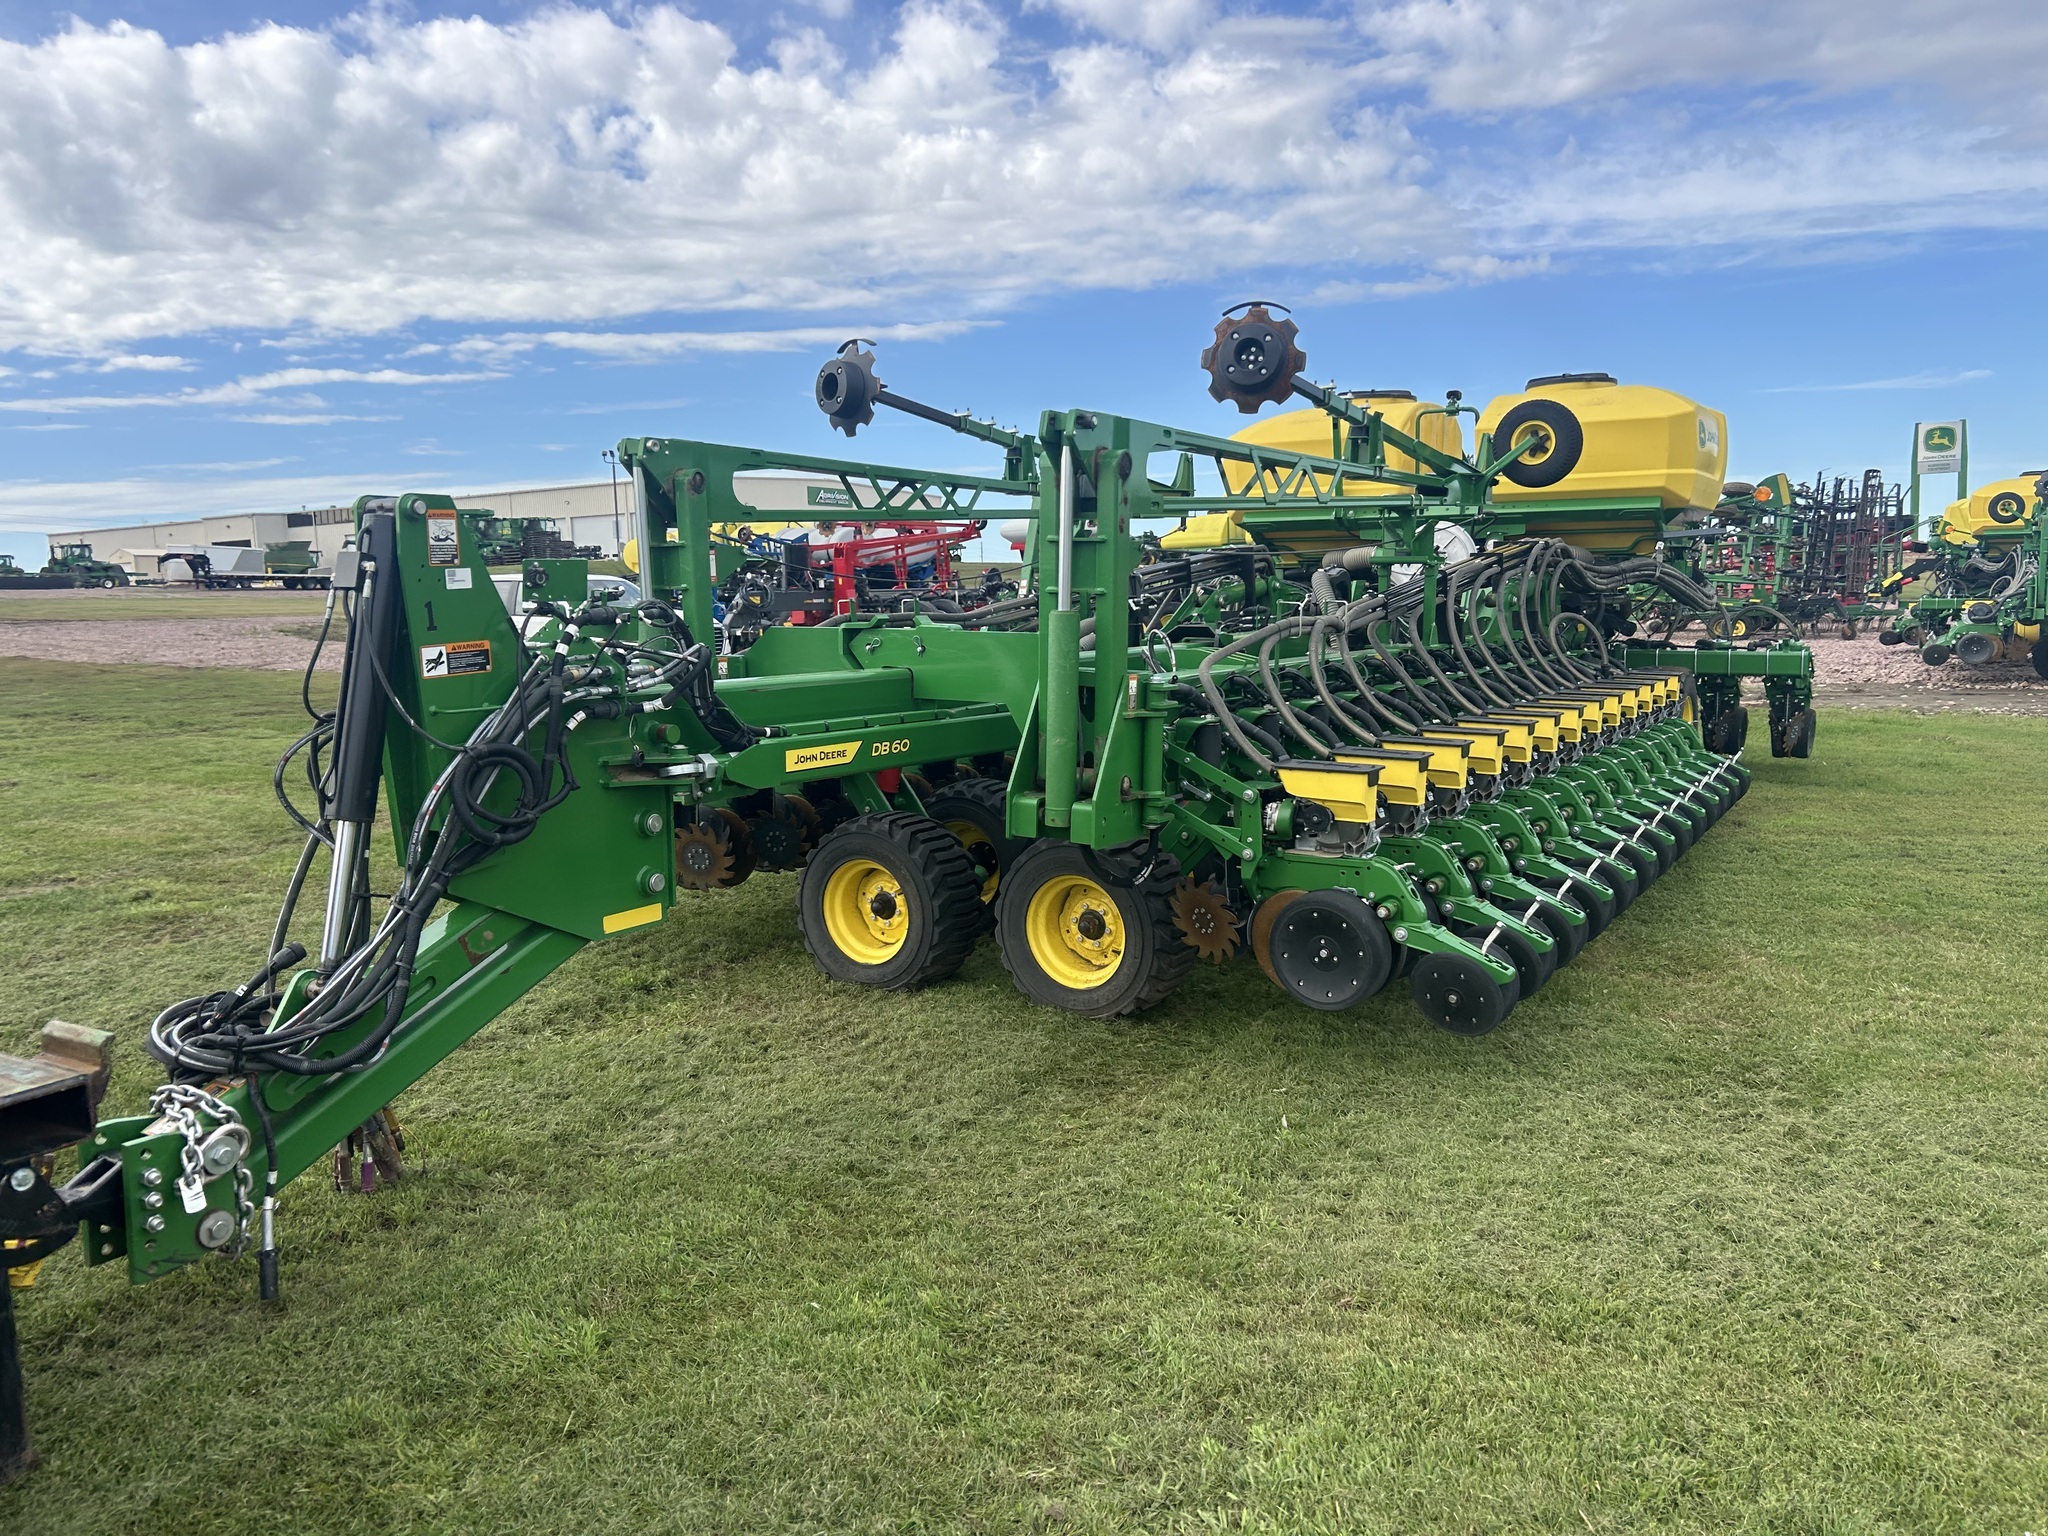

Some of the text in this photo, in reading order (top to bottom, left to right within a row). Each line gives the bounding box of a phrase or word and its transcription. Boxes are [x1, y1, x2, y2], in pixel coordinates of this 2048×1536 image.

[424, 600, 438, 632] 1
[456, 642, 485, 651] WARNING
[794, 749, 848, 765] JOHN DEERE
